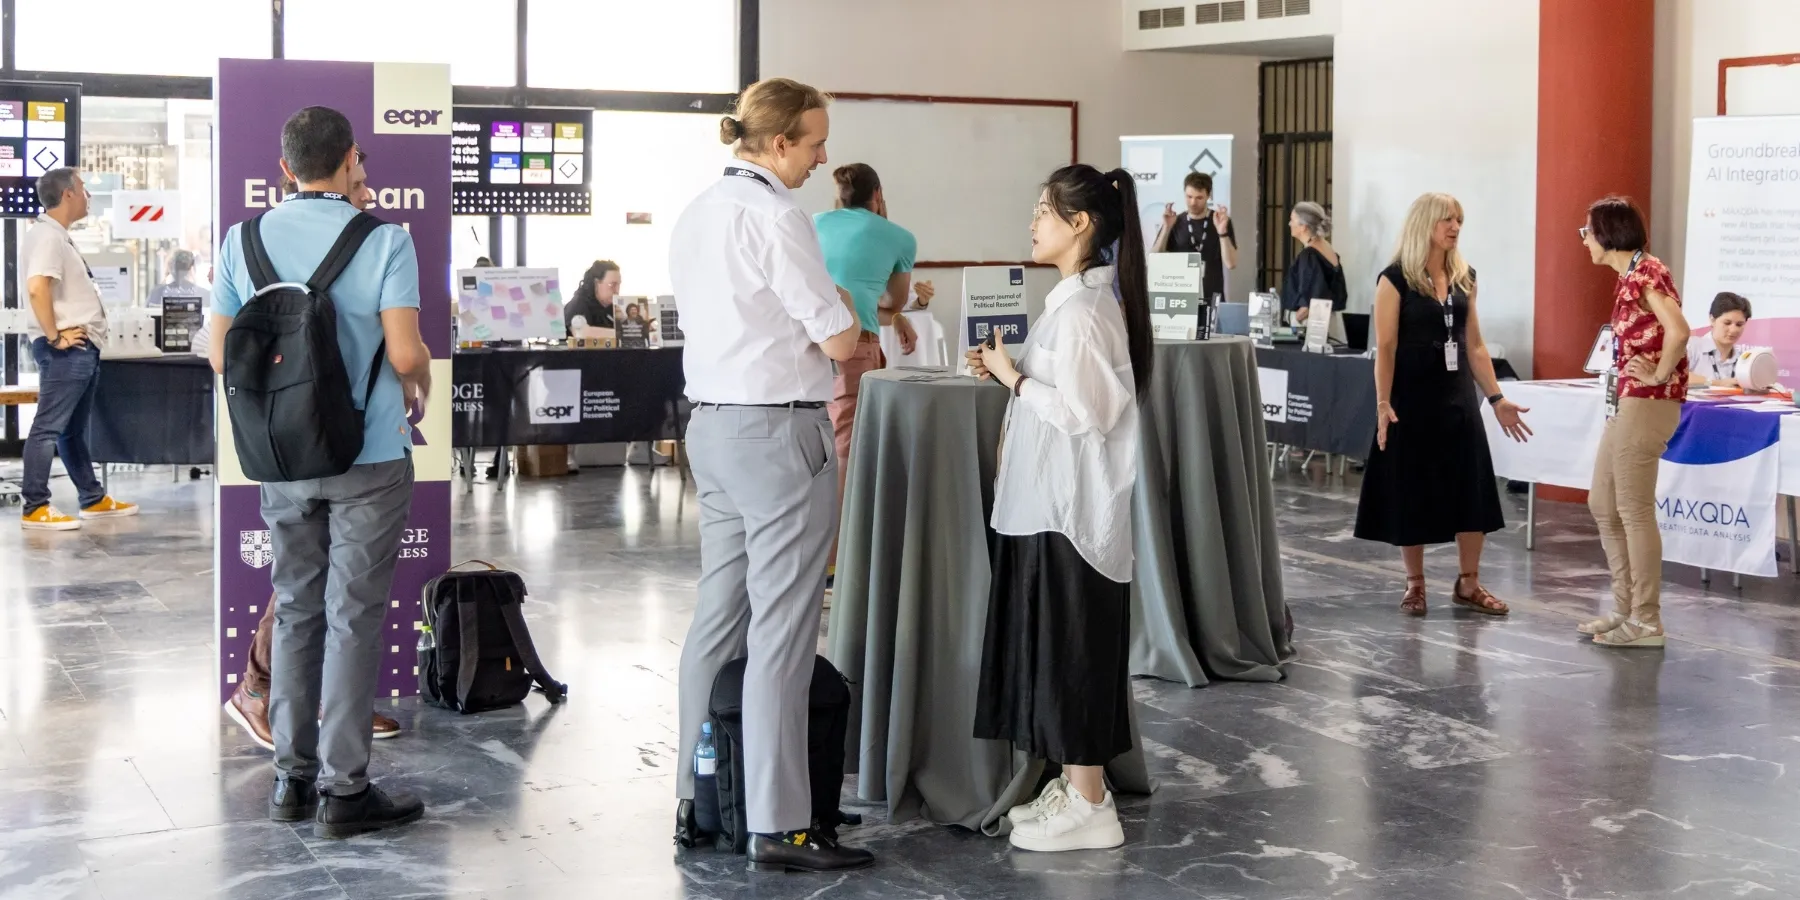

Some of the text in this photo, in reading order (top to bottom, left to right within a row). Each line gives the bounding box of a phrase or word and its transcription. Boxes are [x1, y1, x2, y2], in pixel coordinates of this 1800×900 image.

[384, 109, 443, 127] ecpr
[452, 136, 478, 146] ditorial
[1708, 142, 1800, 159] Groundbrea
[462, 155, 480, 164] Hub
[1133, 172, 1158, 181] ecpr
[1706, 167, 1800, 186] AI Integratio
[244, 178, 425, 210] Euean
[323, 191, 343, 200] ecpr
[971, 294, 995, 302] European
[996, 293, 1015, 301] Journal
[1169, 299, 1187, 308] EPS
[583, 397, 620, 405] Consortium
[535, 405, 574, 419] ecpr
[594, 404, 620, 412] Political
[1262, 403, 1282, 416] cpr
[401, 529, 429, 543] GE
[1660, 522, 1751, 542] REATIVE DATA ANALYSIS
[399, 548, 428, 558] ESS
